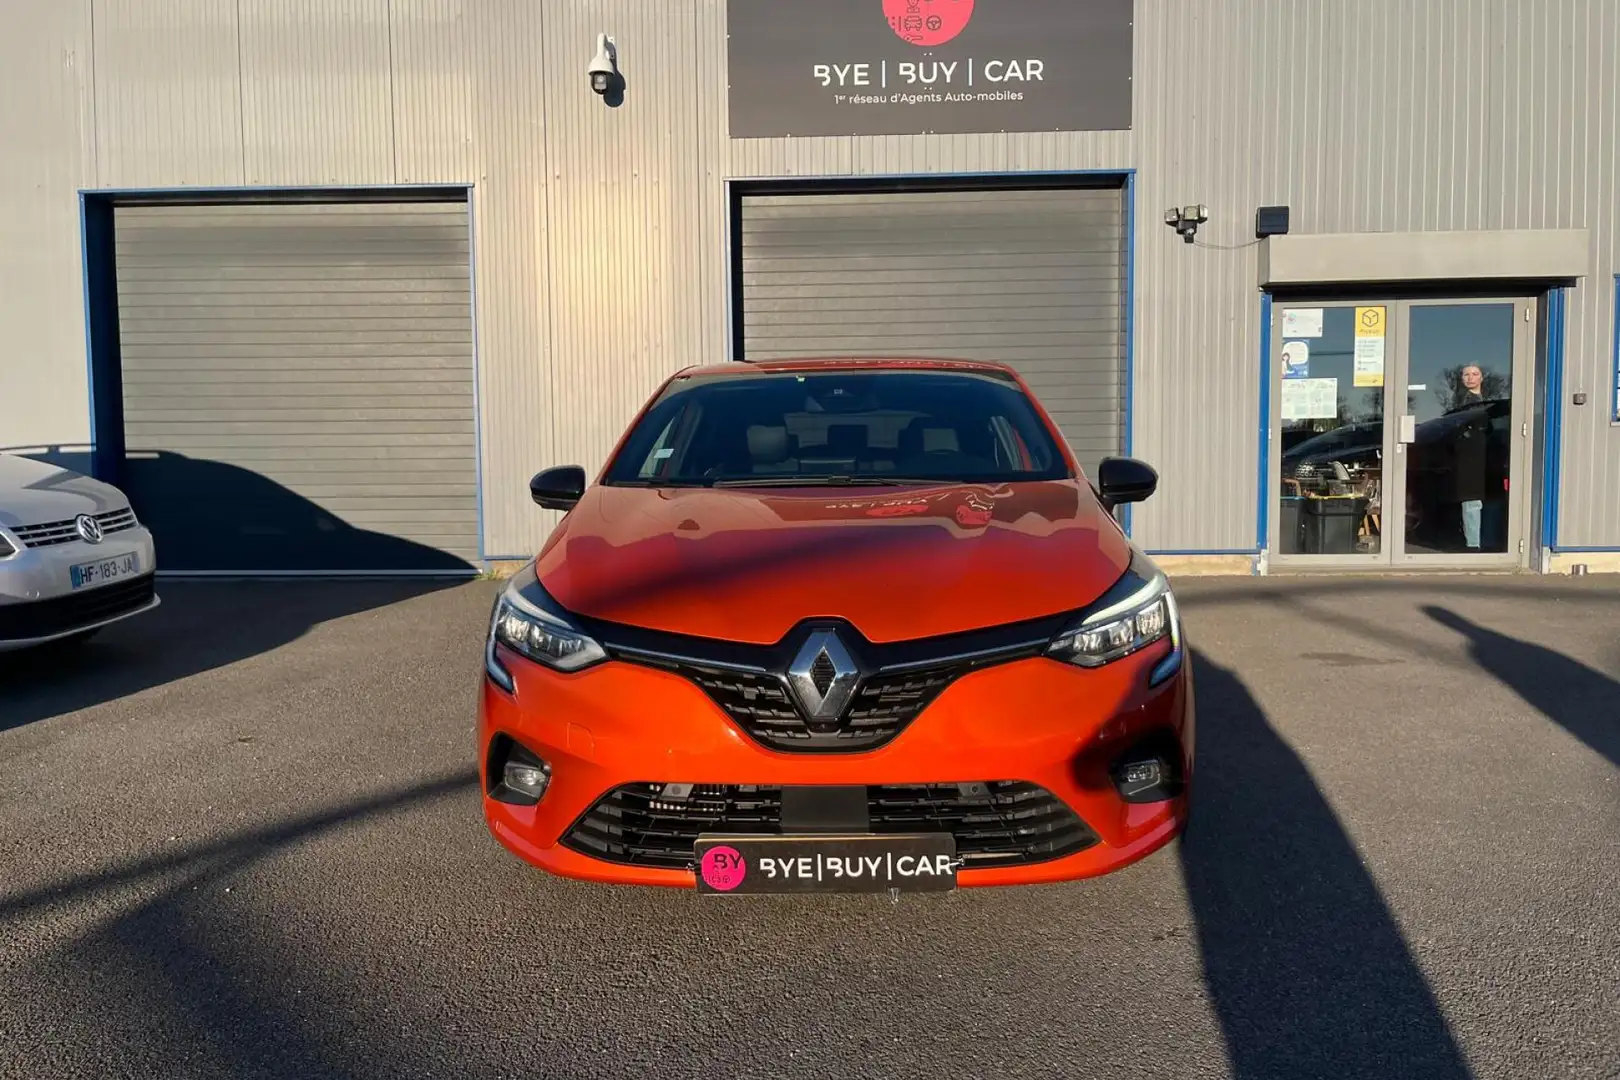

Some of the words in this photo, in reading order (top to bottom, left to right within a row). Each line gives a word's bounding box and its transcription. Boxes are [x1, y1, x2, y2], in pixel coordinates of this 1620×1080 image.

[813, 63, 870, 86] BYE
[984, 59, 1044, 82] CAR
[849, 93, 887, 105] réseau
[890, 91, 942, 105] d'Agents
[944, 90, 1024, 103] Auto-mobiles
